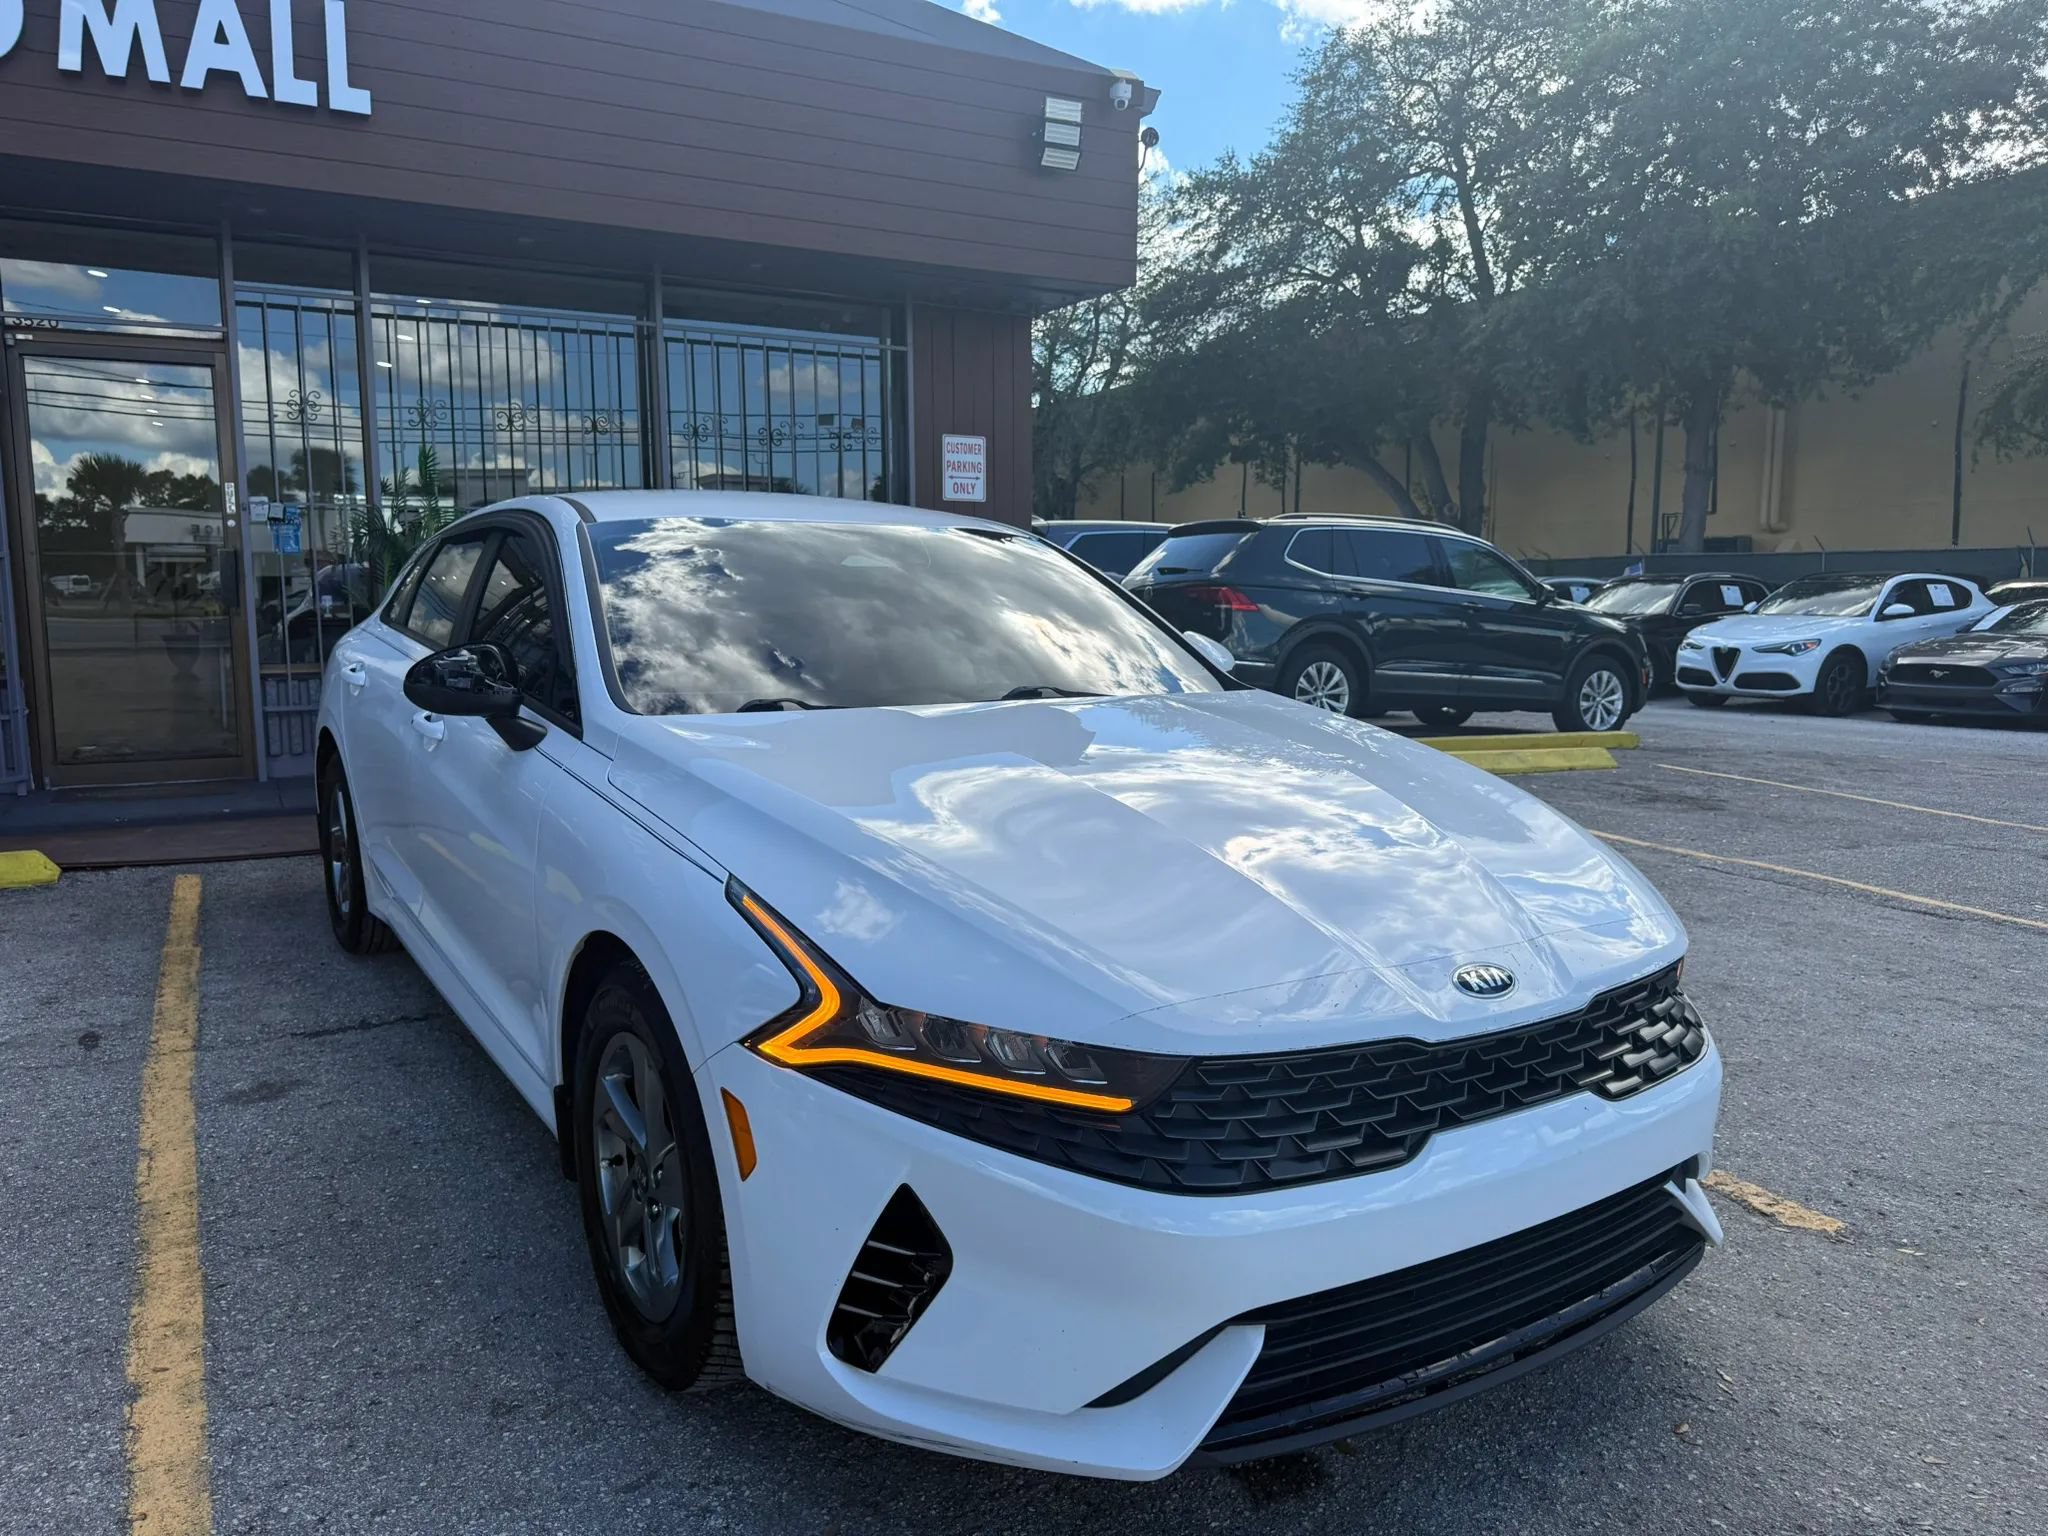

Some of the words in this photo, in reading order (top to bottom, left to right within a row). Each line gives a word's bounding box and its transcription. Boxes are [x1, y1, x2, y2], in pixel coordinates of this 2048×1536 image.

[58, 0, 372, 115] MALL
[946, 441, 982, 456] CUSTOMER
[946, 460, 983, 474] PARKING
[952, 481, 976, 495] ONLY
